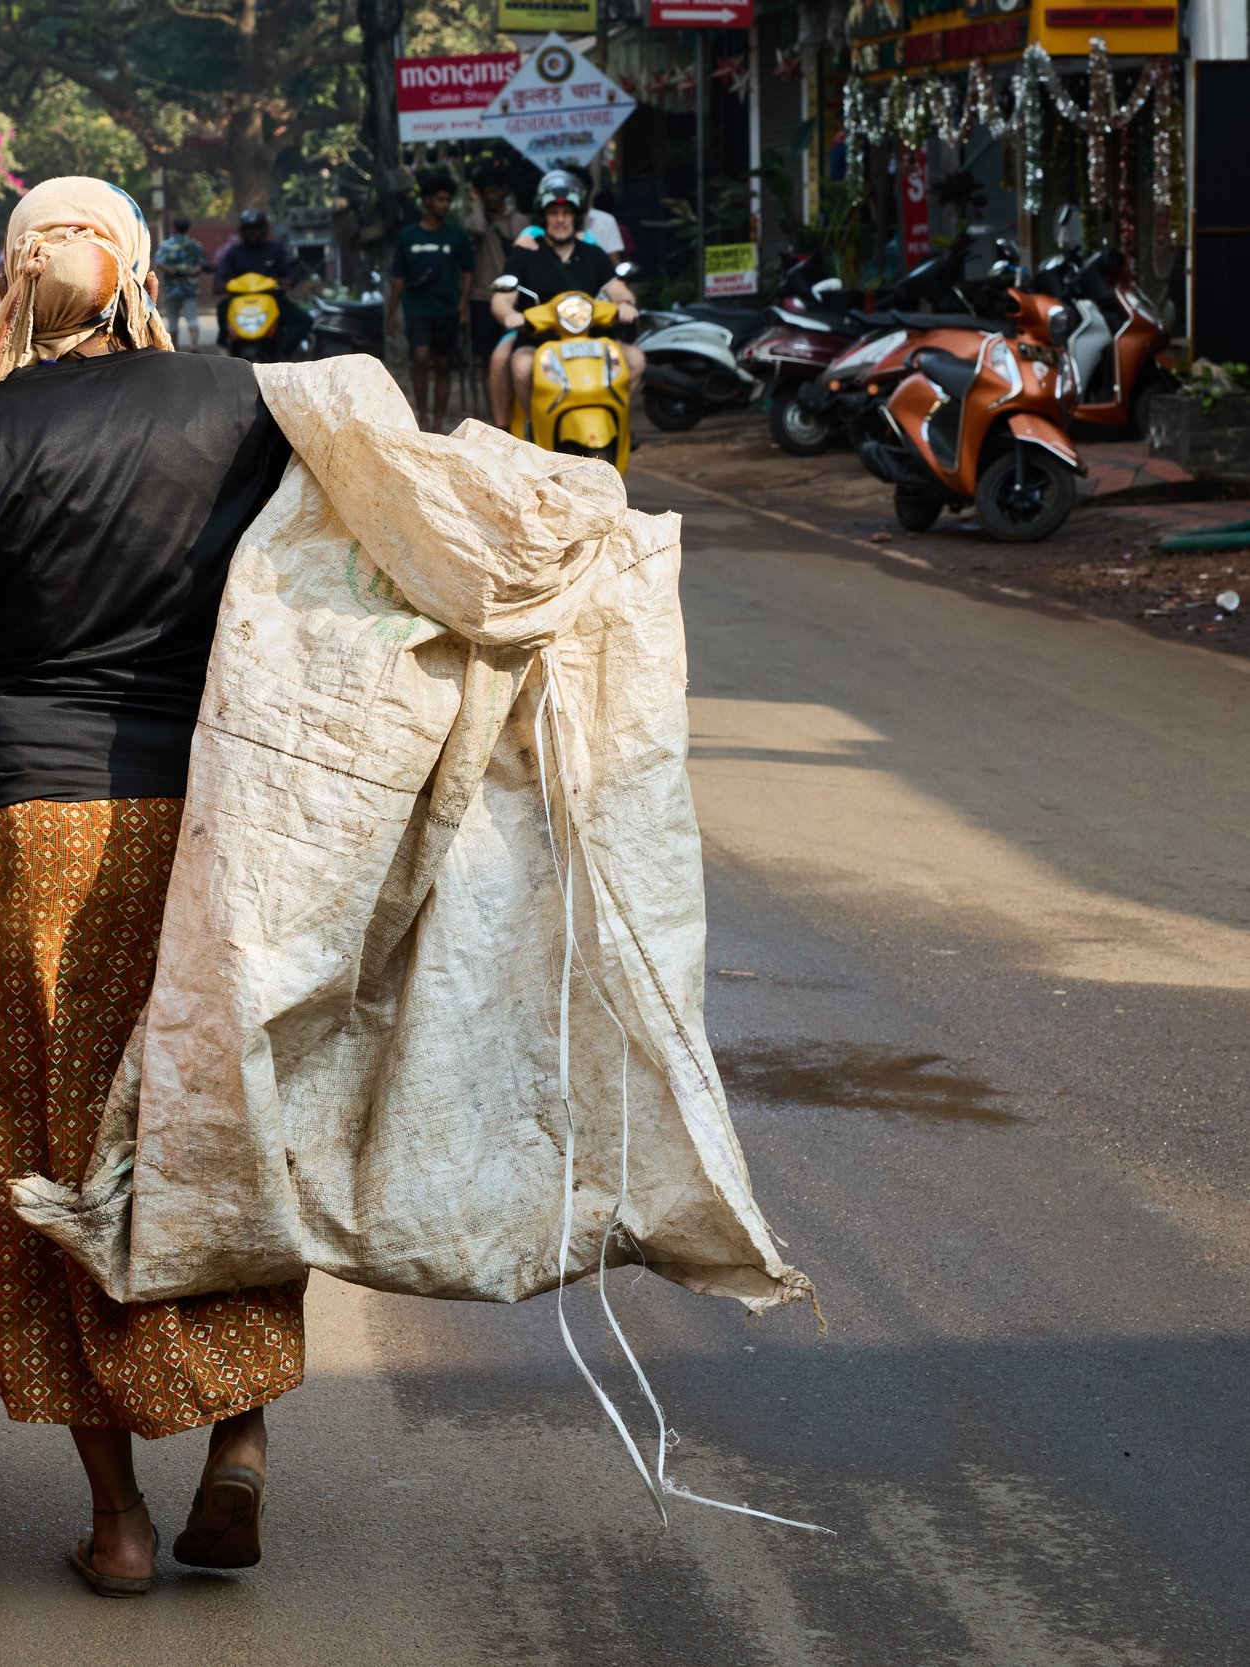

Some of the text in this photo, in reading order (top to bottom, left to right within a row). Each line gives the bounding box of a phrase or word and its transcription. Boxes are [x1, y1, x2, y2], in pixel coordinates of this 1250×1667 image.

[429, 91, 462, 105] Cake
[505, 110, 614, 133] GENERAL STORE
